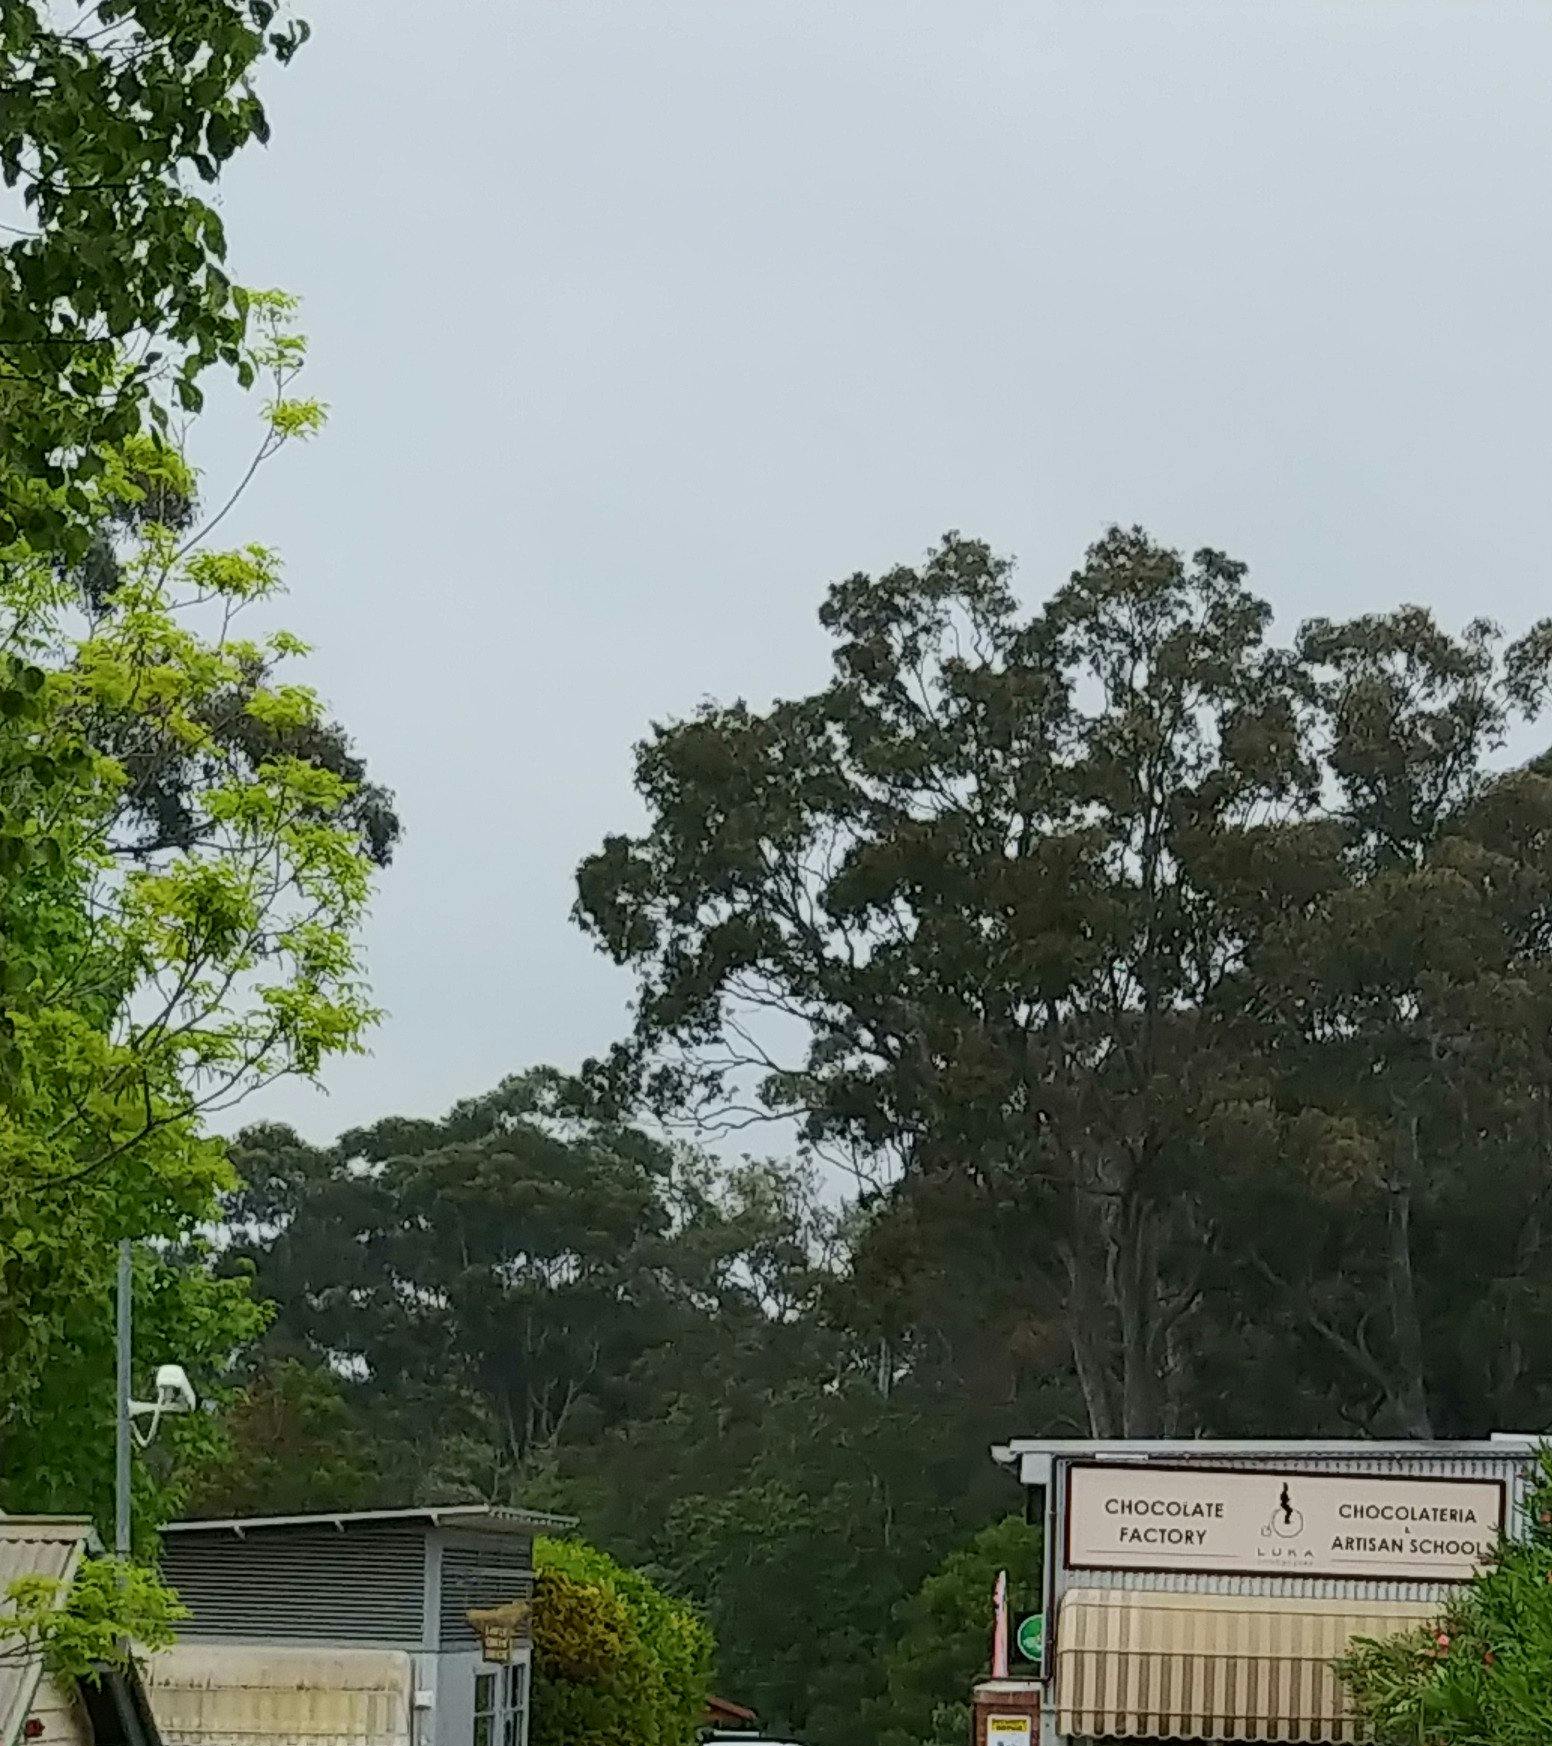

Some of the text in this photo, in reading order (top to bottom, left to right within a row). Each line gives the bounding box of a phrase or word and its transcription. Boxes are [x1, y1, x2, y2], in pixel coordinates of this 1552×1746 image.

[1104, 1498, 1225, 1518] CHOCOLATE
[1338, 1503, 1478, 1523] CHOCOLATERIA
[1118, 1526, 1207, 1545] FACTORY
[1331, 1535, 1484, 1557] ARTISAN SCHOOL
